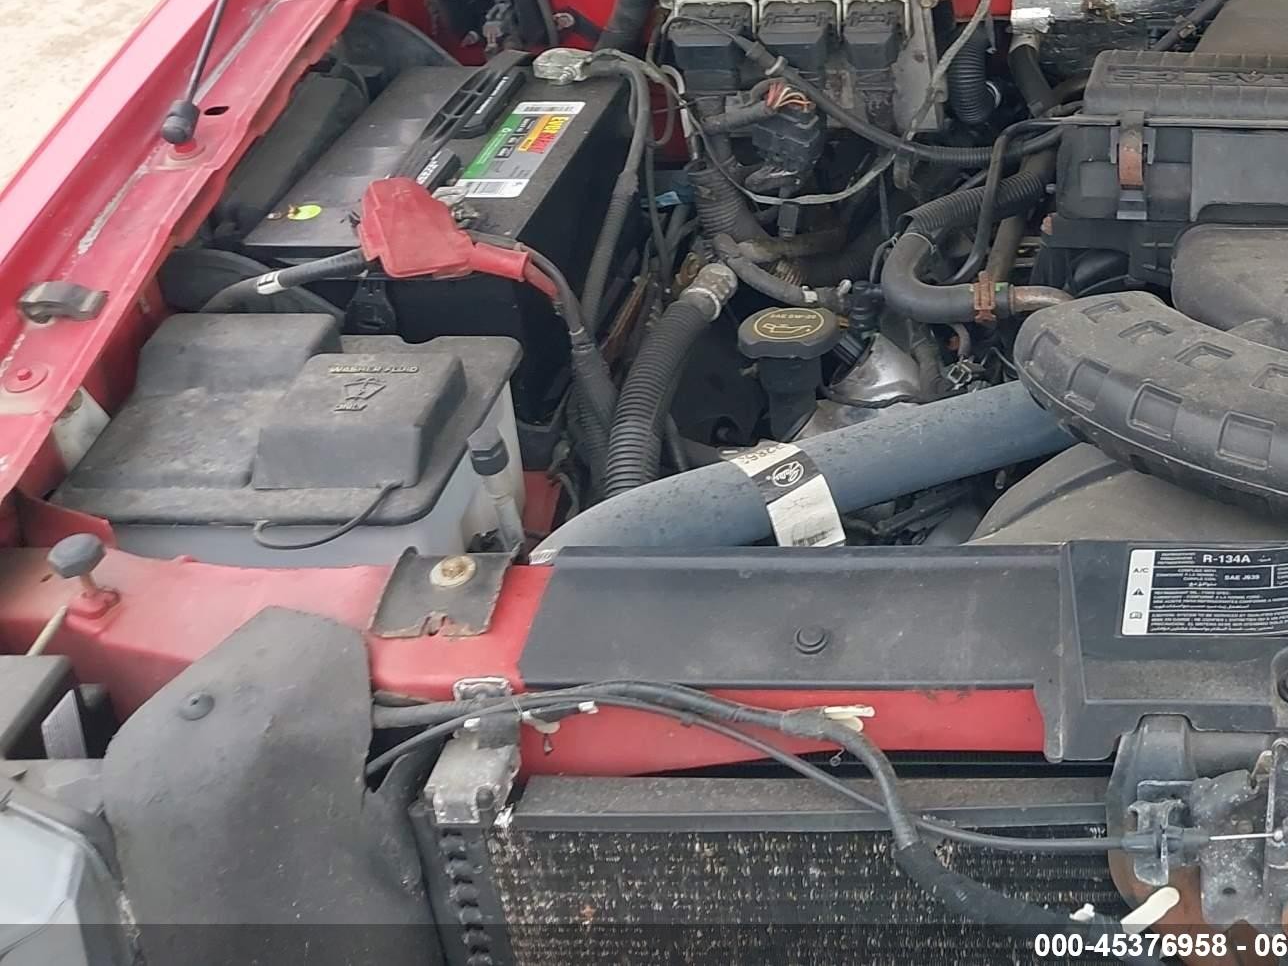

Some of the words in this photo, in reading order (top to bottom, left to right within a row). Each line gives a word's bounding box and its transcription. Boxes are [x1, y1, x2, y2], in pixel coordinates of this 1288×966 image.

[328, 363, 382, 374] WASHER
[383, 365, 420, 374] FLUID
[1202, 554, 1252, 564] R-134A
